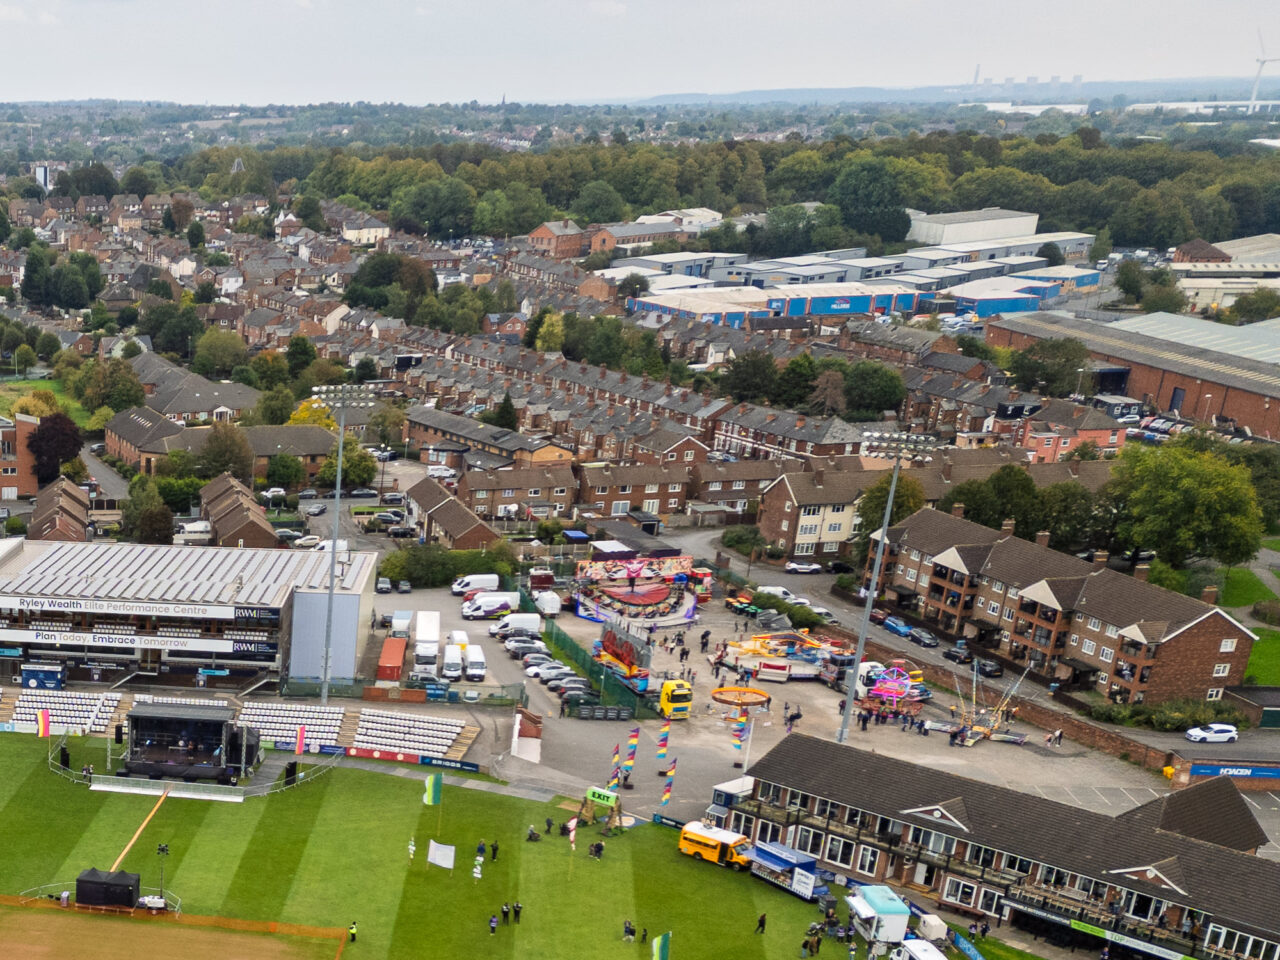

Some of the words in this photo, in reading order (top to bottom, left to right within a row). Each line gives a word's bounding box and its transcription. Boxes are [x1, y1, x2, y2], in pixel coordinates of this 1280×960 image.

[20, 599, 45, 609] Ryley
[48, 599, 82, 609] Wealth
[84, 601, 104, 610] Elite
[107, 602, 169, 613] Performance
[173, 605, 207, 615] Centre
[235, 608, 257, 617] RWM
[35, 632, 56, 641] Plan
[59, 633, 90, 643] Today,
[92, 634, 136, 645] Embrace
[138, 637, 188, 647] Tomorrow
[234, 643, 255, 652] RWM
[592, 791, 610, 802] EXIT
